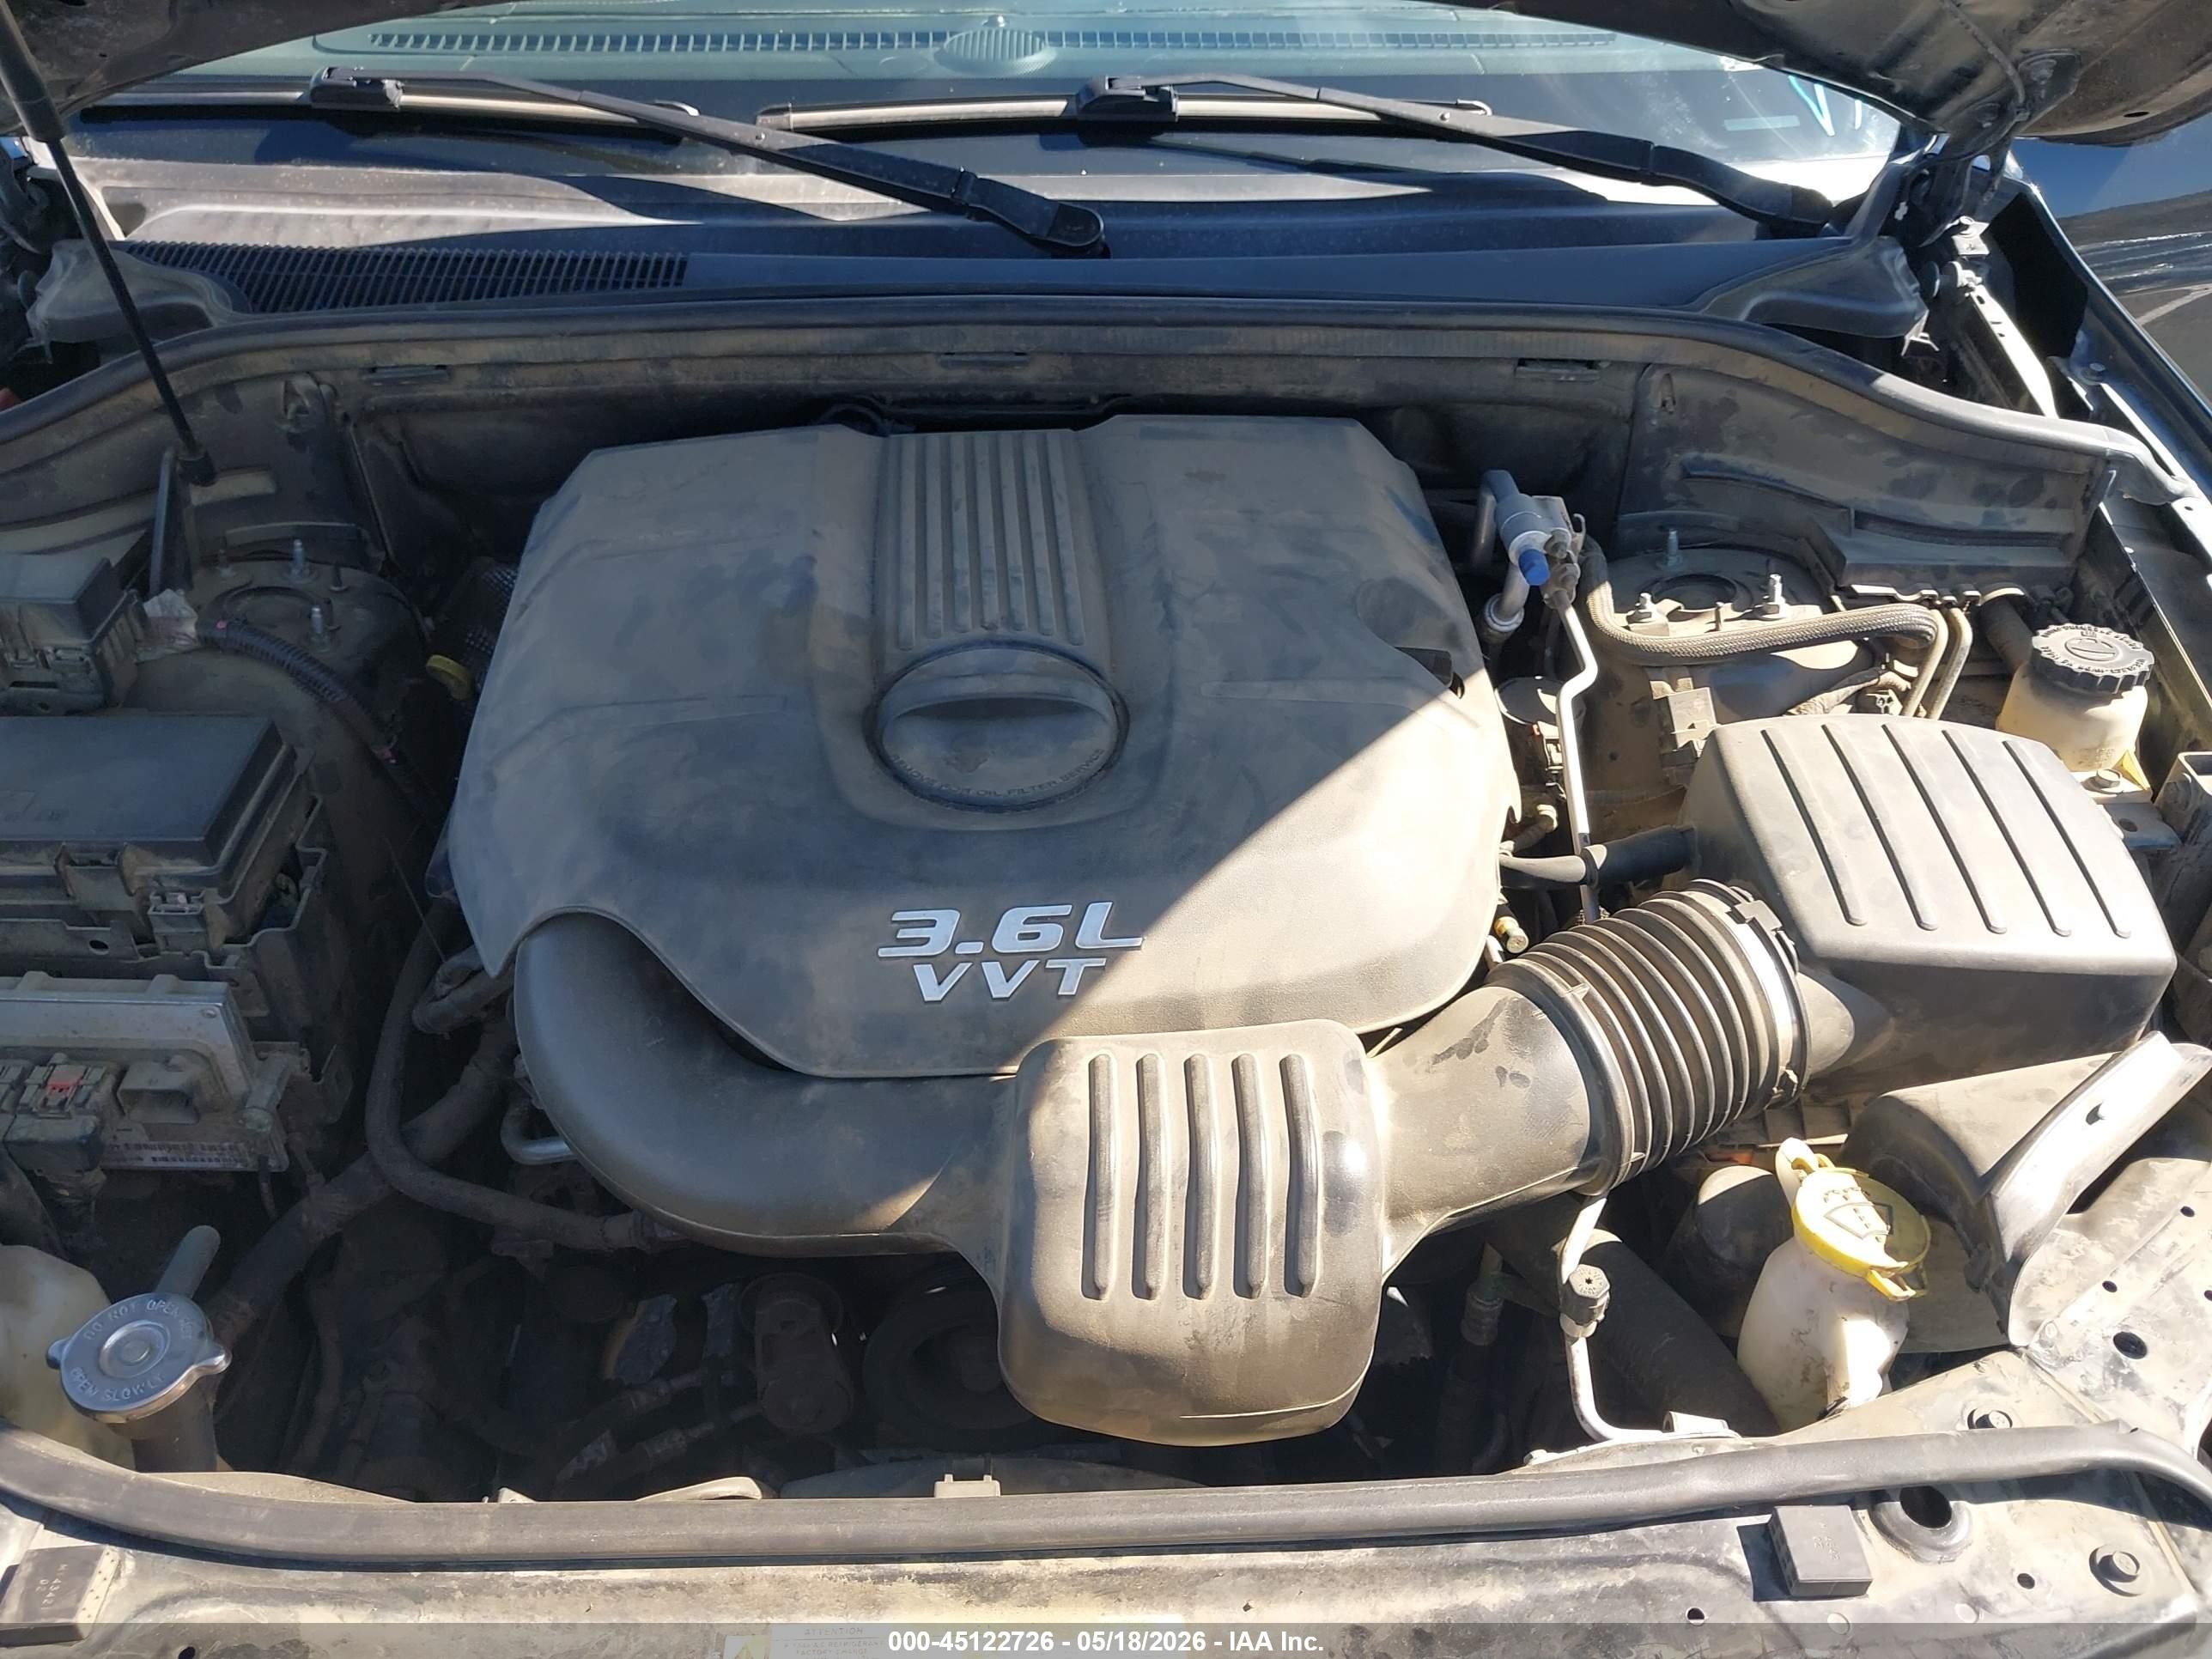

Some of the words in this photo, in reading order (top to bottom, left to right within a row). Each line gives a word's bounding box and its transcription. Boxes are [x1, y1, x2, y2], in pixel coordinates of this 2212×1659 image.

[975, 787, 1002, 798] OIL
[1007, 780, 1058, 798] FILTER
[878, 901, 1144, 957] 3.6L
[913, 957, 1107, 1002] VVT
[83, 1321, 103, 1341] DO
[107, 1301, 137, 1322] NOT
[145, 1298, 179, 1319] OPEN
[70, 1366, 99, 1398] OPEN
[103, 1373, 166, 1402] SLOWLY
